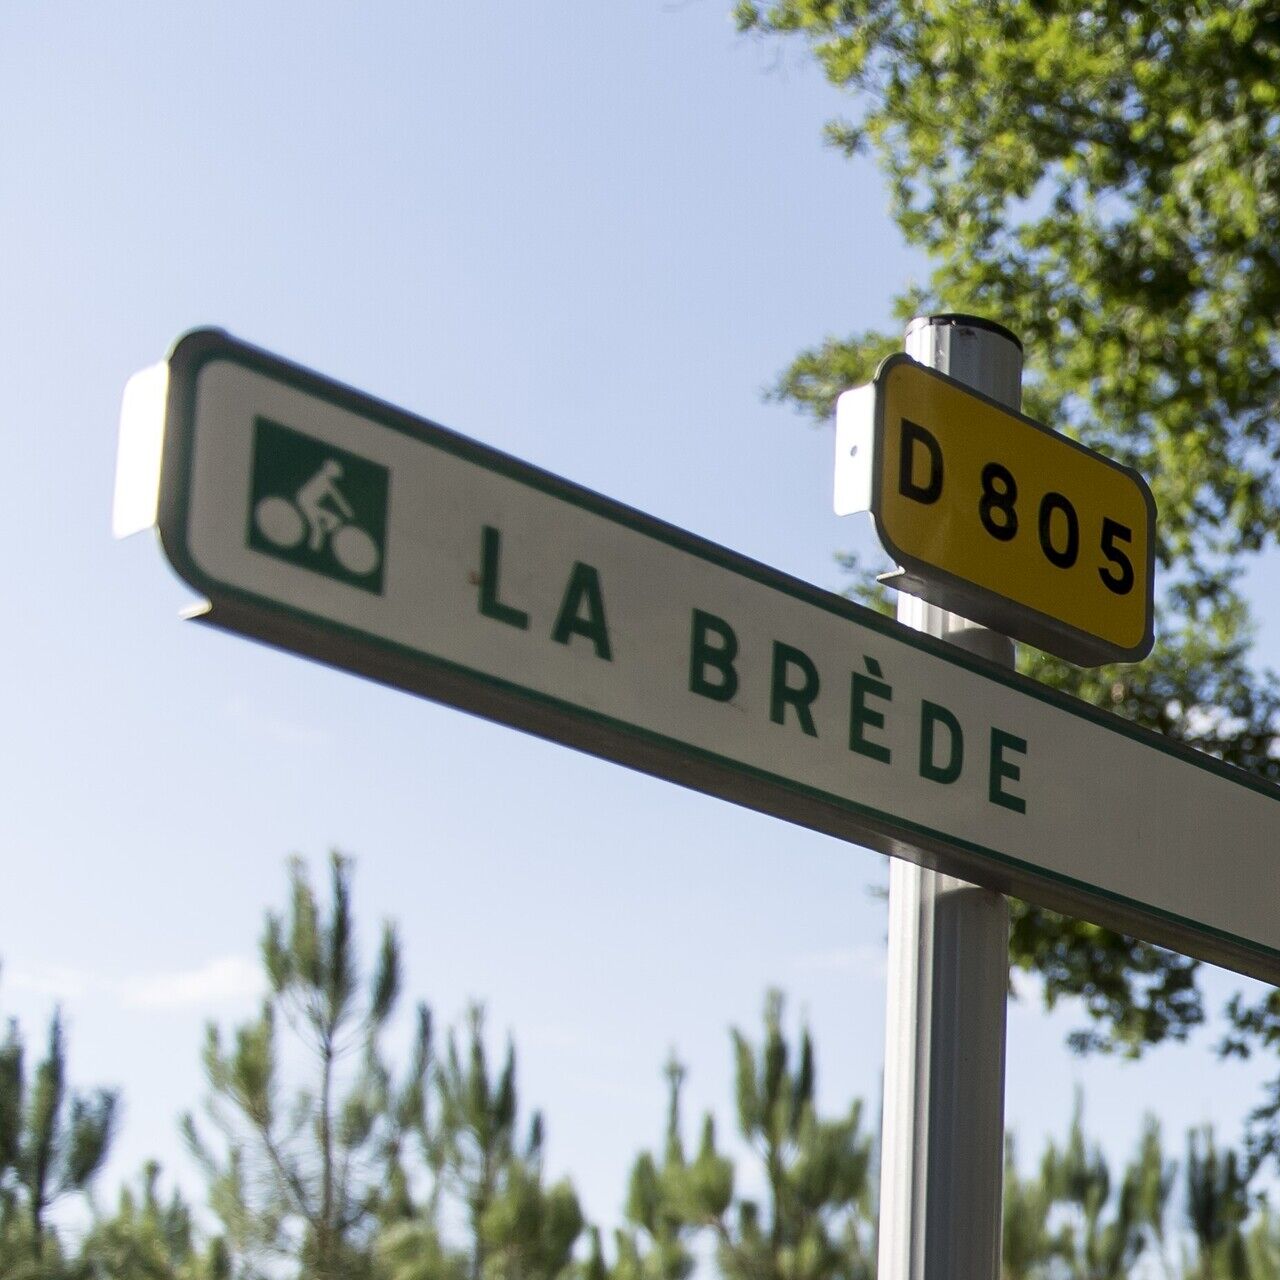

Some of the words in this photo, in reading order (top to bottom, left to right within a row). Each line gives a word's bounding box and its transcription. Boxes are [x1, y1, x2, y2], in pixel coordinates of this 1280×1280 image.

[897, 417, 945, 506] D
[977, 460, 1135, 597] 805
[472, 524, 614, 663] LA
[688, 607, 1028, 816] BRÈDE
